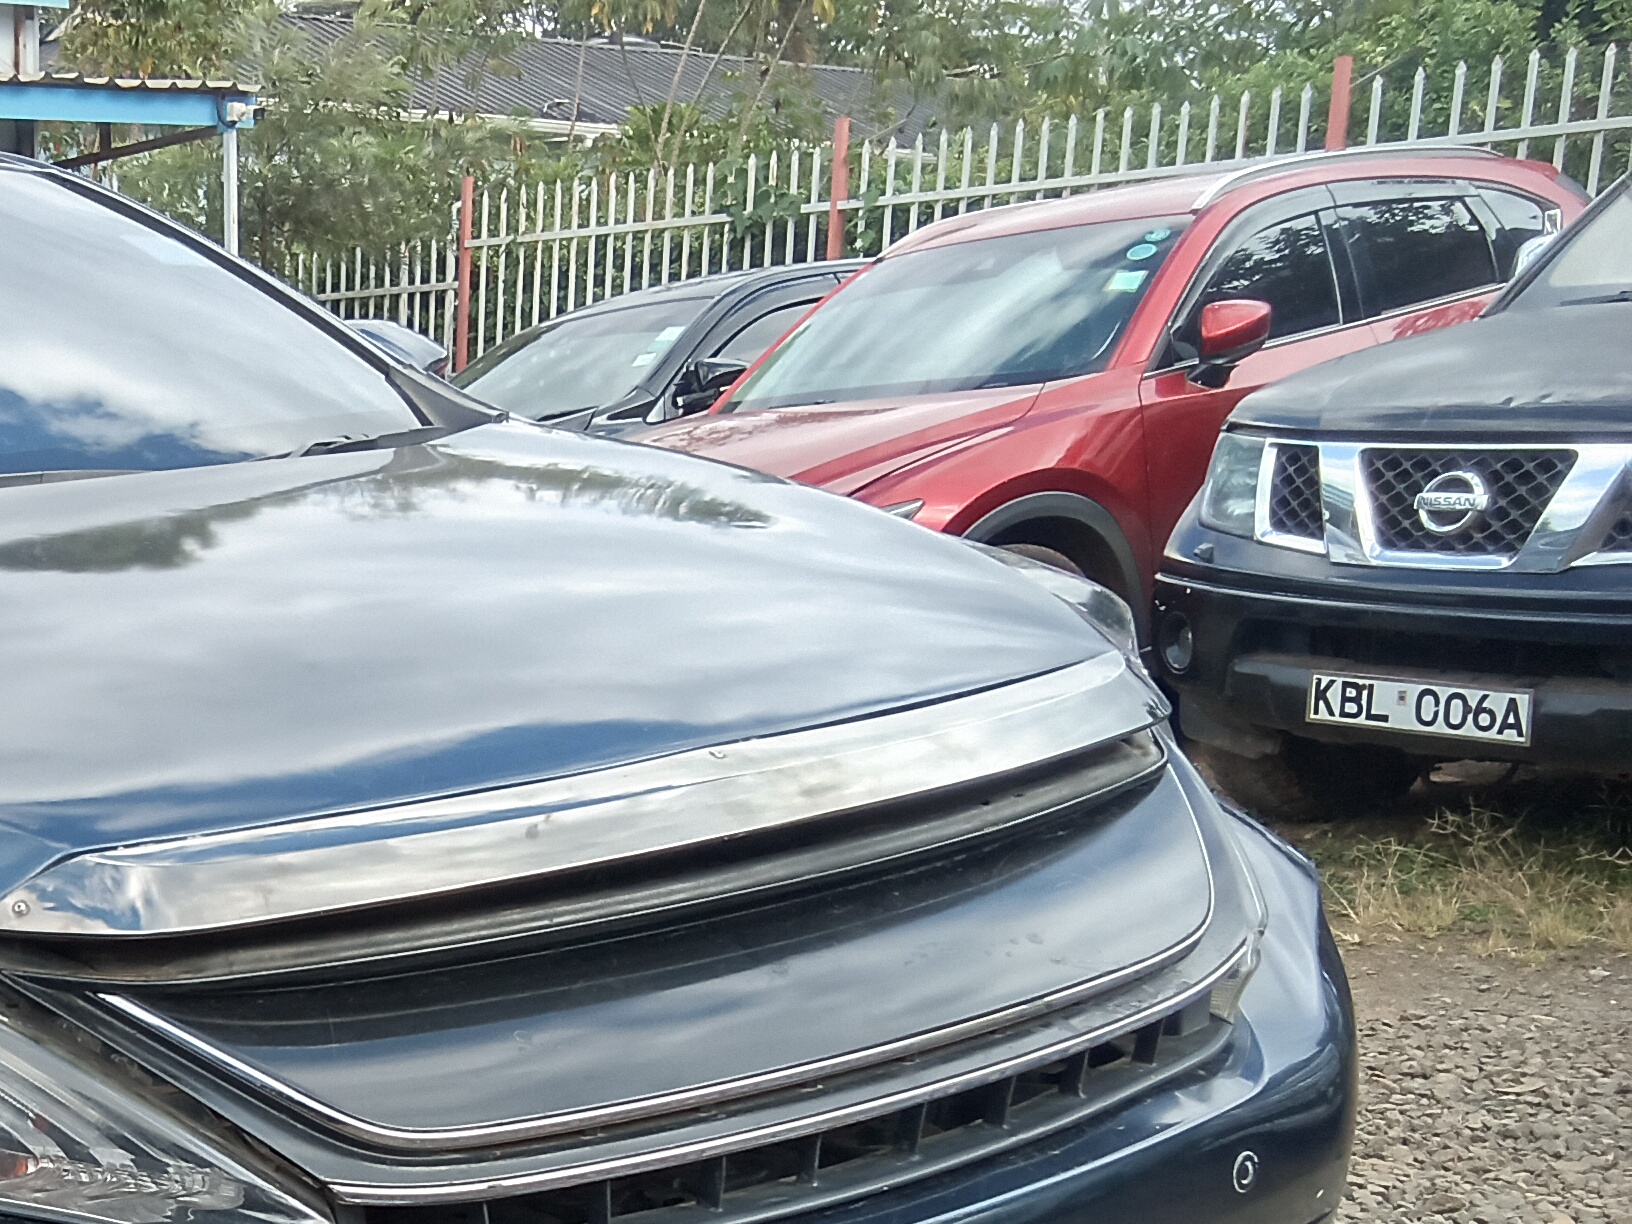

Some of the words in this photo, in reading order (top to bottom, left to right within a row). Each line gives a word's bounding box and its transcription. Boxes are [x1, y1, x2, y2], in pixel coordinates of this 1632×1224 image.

[1418, 495, 1477, 508] NISSAN
[1312, 677, 1389, 723] KBL
[1414, 687, 1525, 738] 006A
